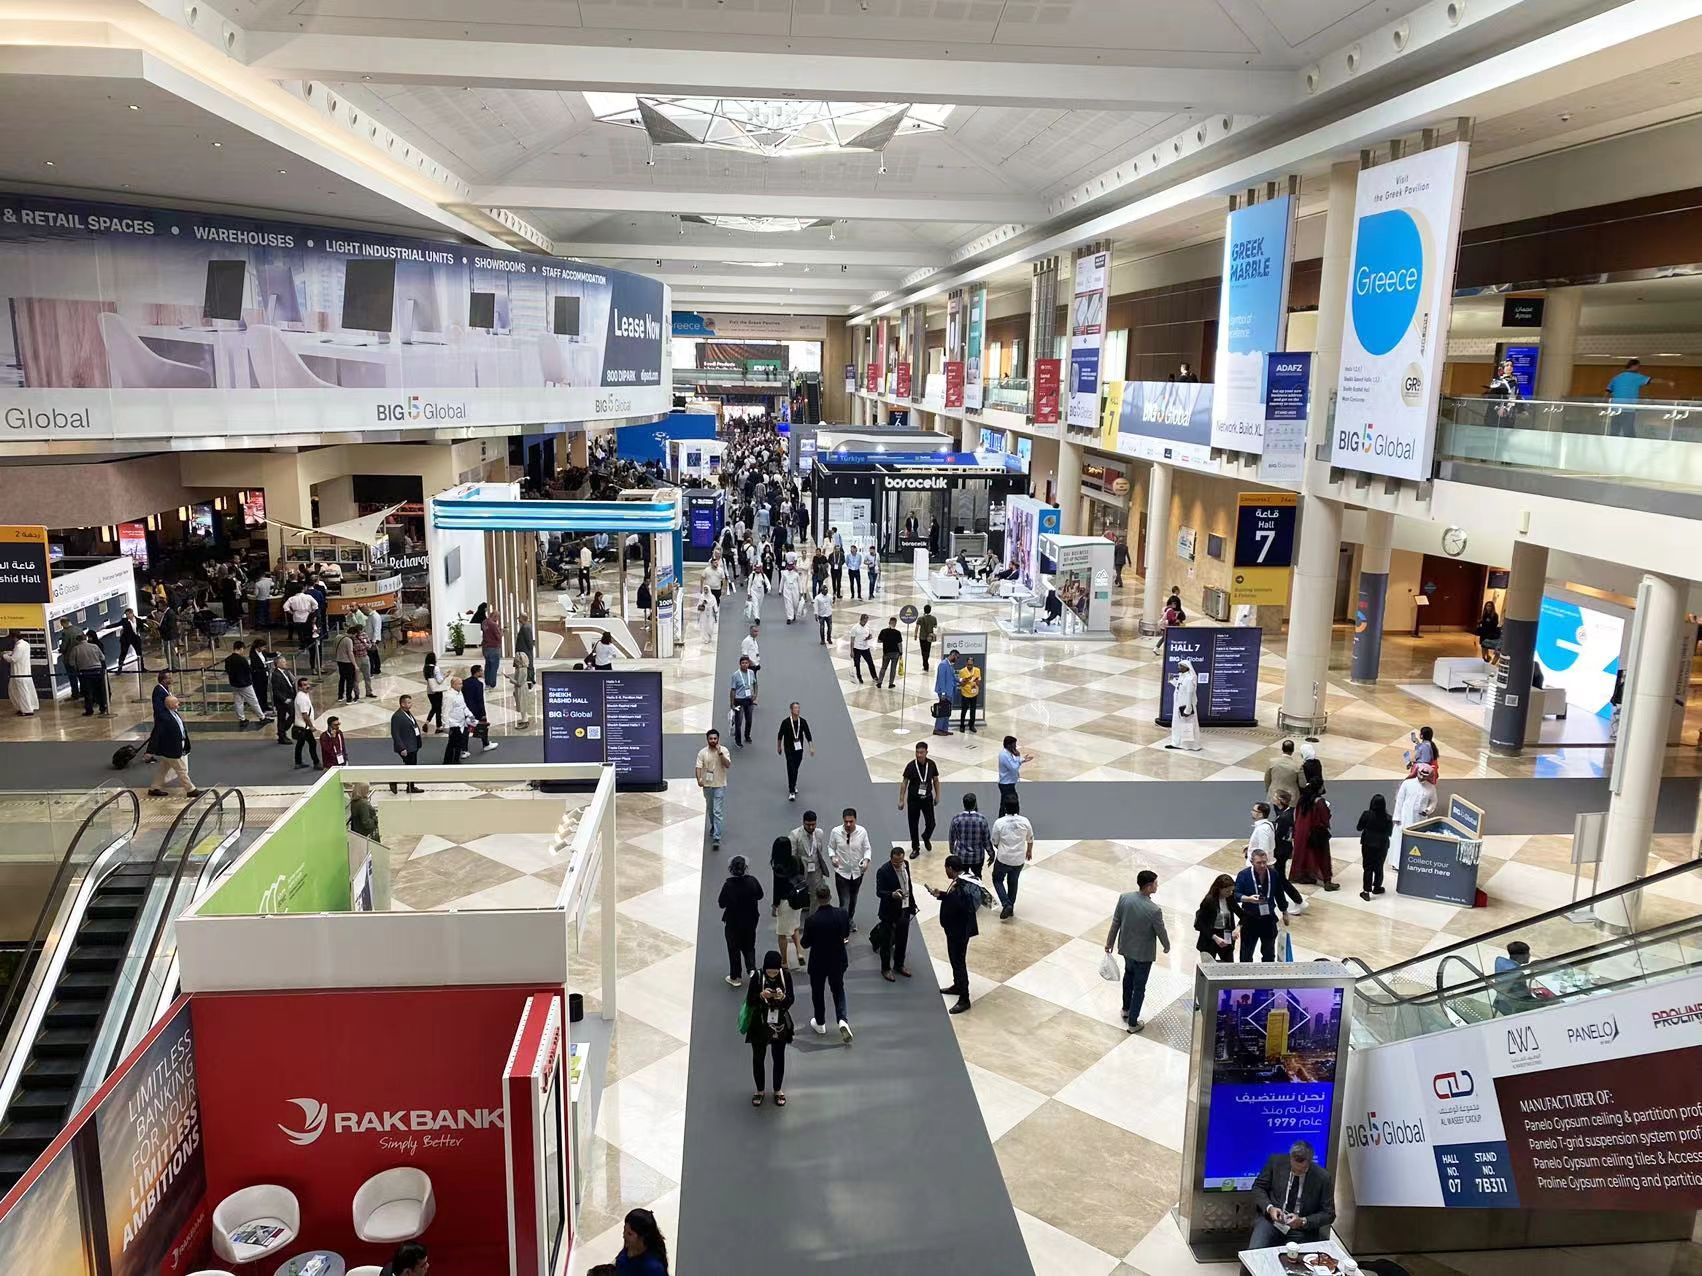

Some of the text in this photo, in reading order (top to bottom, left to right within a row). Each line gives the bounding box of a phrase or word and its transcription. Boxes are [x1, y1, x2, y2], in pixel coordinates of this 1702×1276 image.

[1396, 175, 1408, 185] Visit
[1374, 183, 1430, 202] the Greek Pavilion
[3, 208, 606, 285] & RETAIL SPACES WAREHOUSES LIGHT INDUSTRIAL UNITS SHOWROOMS STAFF ACCOMMODATION
[1232, 237, 1264, 262] GREEK
[1230, 257, 1271, 282] MARBLE
[1356, 266, 1418, 296] Greece
[614, 308, 644, 338] Lease
[645, 313, 660, 341] Now
[617, 370, 636, 382] DIPARK
[376, 402, 404, 422] BIG
[423, 402, 466, 420] Global
[594, 399, 607, 414] BIG
[614, 398, 632, 414] Global
[1165, 404, 1191, 427] Global
[4, 408, 91, 430] Global
[1108, 410, 1114, 436] 7
[1338, 430, 1359, 452] BIG
[1375, 434, 1416, 460] Global
[1255, 508, 1279, 518] قاعة
[1255, 530, 1275, 563] 7
[11, 561, 35, 570] قاعة
[21, 575, 41, 584] Hall
[1407, 864, 1450, 877] lanyard here
[1408, 857, 1432, 866] Collect
[1567, 1022, 1613, 1043] PANELO
[128, 1028, 192, 1123] LIMITLESS
[136, 1053, 194, 1143] BANKING
[1235, 1090, 1325, 1104] نحن نستضيف
[1520, 1090, 1614, 1113] MANUFACTURER OF:
[334, 1107, 504, 1133] RAKBANK
[1260, 1104, 1324, 1116] العالم منذ
[1465, 1114, 1481, 1123] GROUP
[1524, 1118, 1553, 1132] Panelo
[1554, 1115, 1591, 1132] Gypsum
[1592, 1112, 1622, 1126] ceiling
[1624, 1111, 1632, 1122] &
[1633, 1106, 1677, 1124] partition
[132, 1077, 196, 1177] FOR YOUR
[1267, 1117, 1322, 1128] عام 1979
[1346, 1124, 1369, 1148] BIG
[1382, 1118, 1426, 1145] Global
[1529, 1138, 1558, 1151] Panelo
[1559, 1135, 1584, 1151] T-grid
[1585, 1132, 1638, 1150] suspension
[1639, 1130, 1677, 1146] system
[379, 1134, 463, 1156] Simply Better
[130, 1101, 198, 1210] LIMITLESS
[1442, 1153, 1459, 1164] HALL
[1474, 1152, 1497, 1162] STAND
[1533, 1157, 1562, 1169] Panelo
[1562, 1155, 1600, 1171] Gypsum
[1602, 1152, 1634, 1169] ceiling
[1635, 1152, 1656, 1166] tiles
[1658, 1152, 1666, 1164] &
[1447, 1167, 1459, 1176] NO.
[1482, 1166, 1495, 1175] NO.
[122, 1126, 200, 1252] AMBITIONS
[1448, 1179, 1461, 1193] 07
[1475, 1178, 1508, 1194] 7B311
[1537, 1172, 1702, 1191] Proline Gypsum ceiling and partitio
